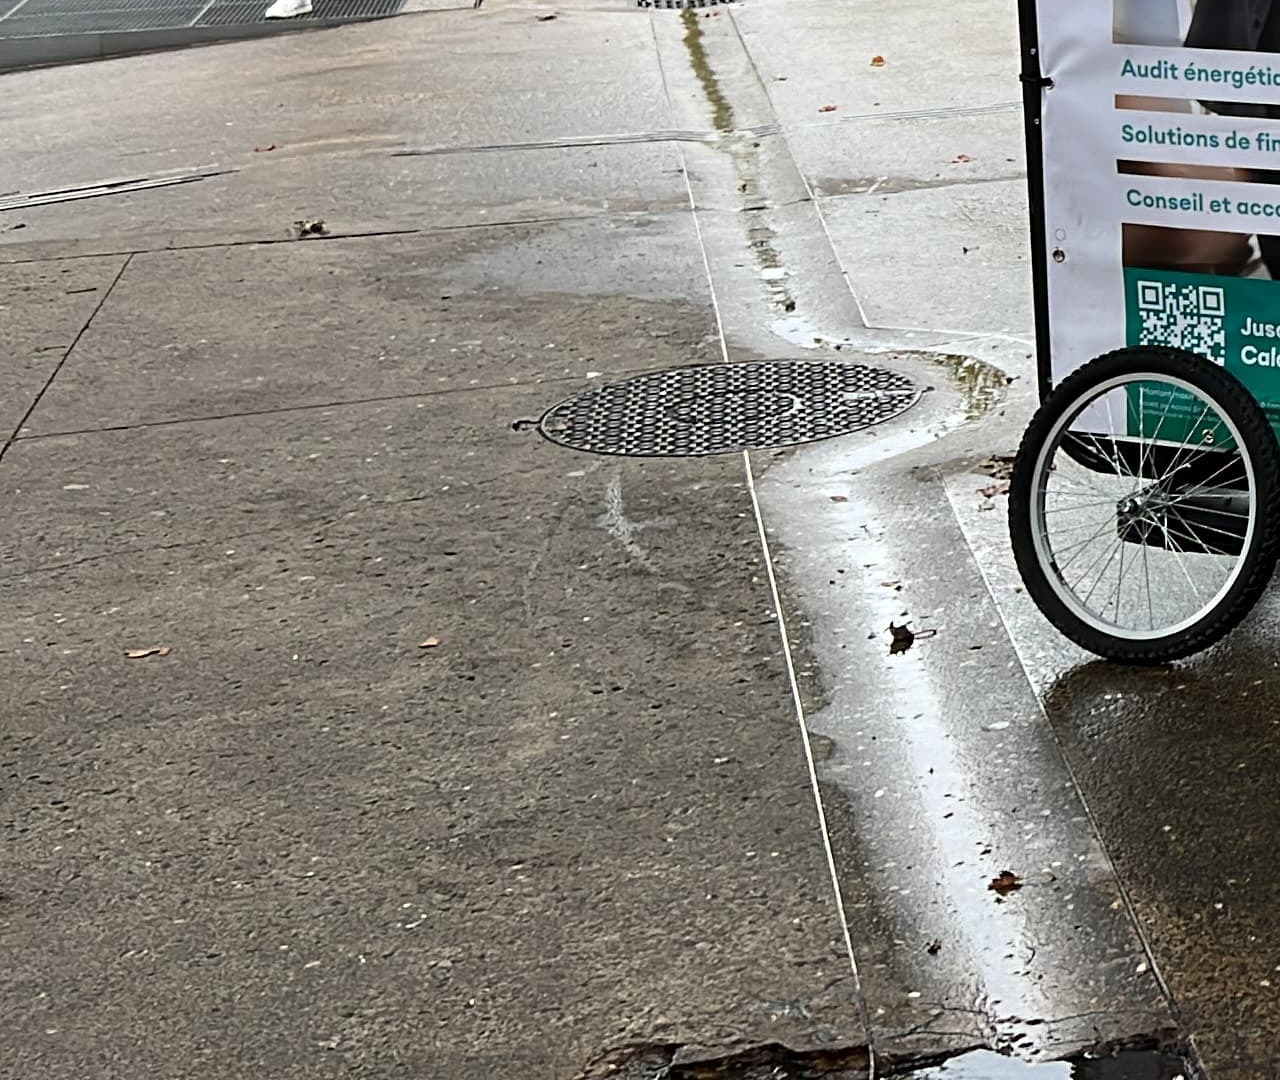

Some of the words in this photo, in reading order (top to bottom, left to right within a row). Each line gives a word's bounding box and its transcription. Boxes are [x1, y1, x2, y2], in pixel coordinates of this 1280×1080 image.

[1120, 58, 1179, 80] Audit
[1121, 124, 1220, 149] Solutions
[1225, 130, 1251, 150] de
[1126, 189, 1204, 212] Conseil
[1209, 197, 1231, 214] et
